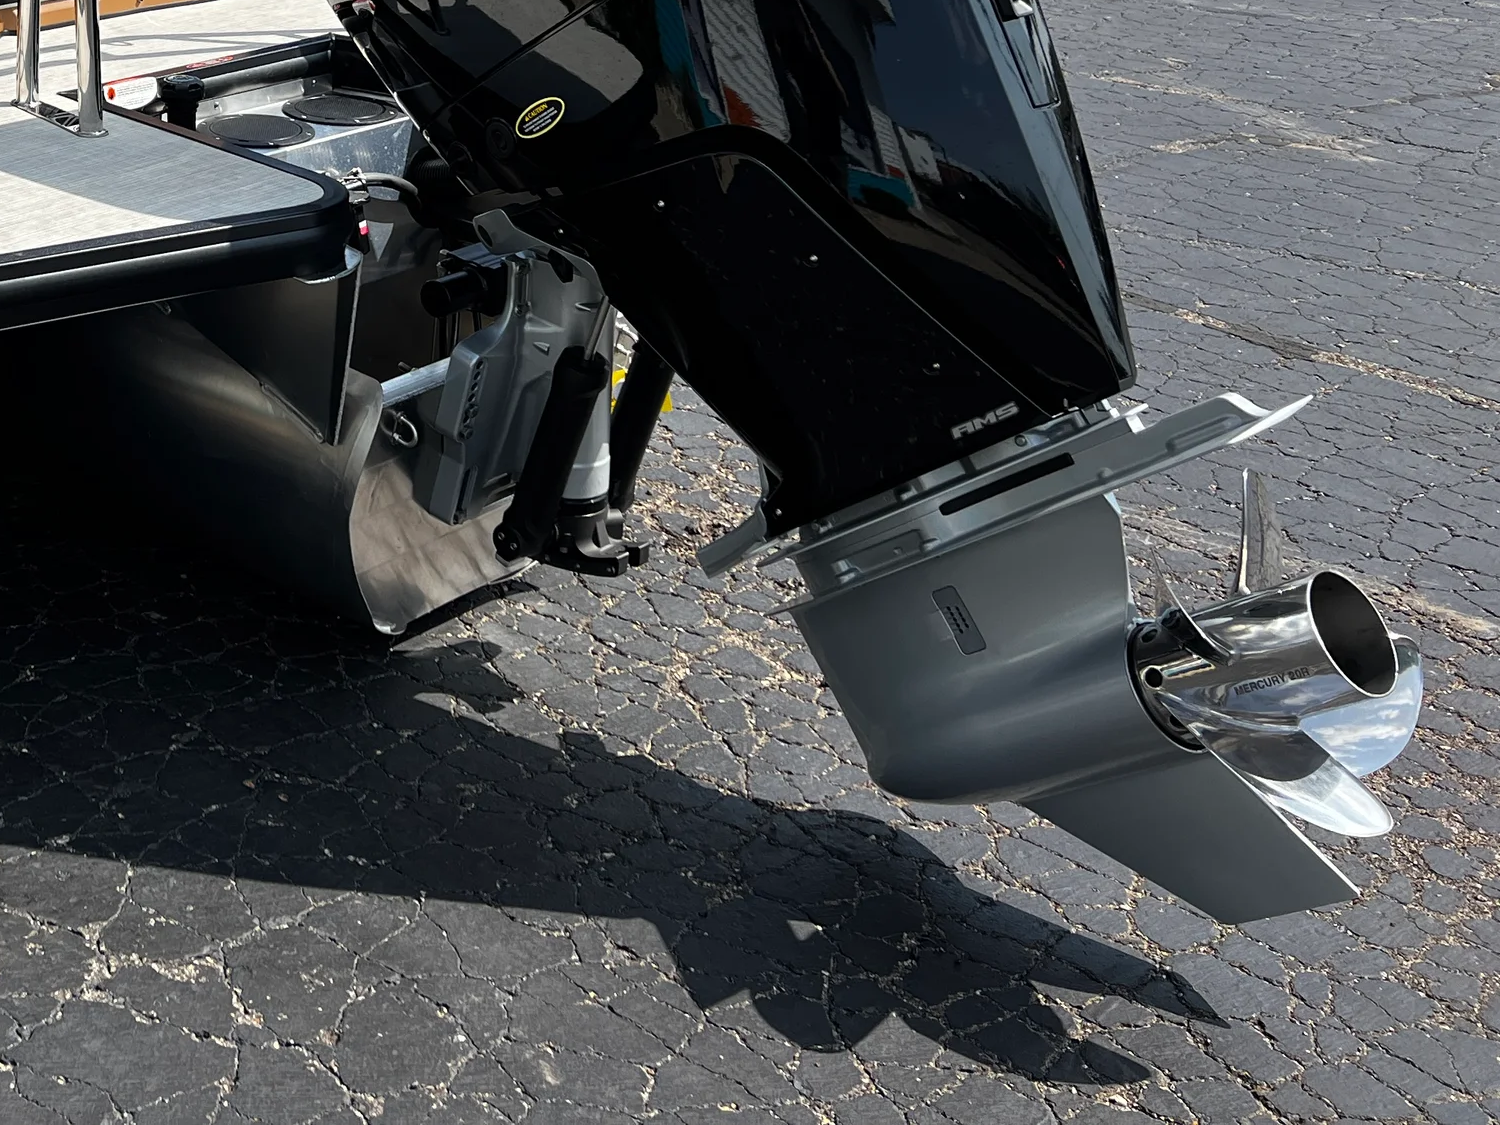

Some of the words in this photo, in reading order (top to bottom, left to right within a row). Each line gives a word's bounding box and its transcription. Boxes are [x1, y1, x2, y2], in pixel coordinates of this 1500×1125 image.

[527, 102, 549, 119] CAUTION
[951, 400, 1020, 440] AMS
[1233, 672, 1287, 696] MERCURY
